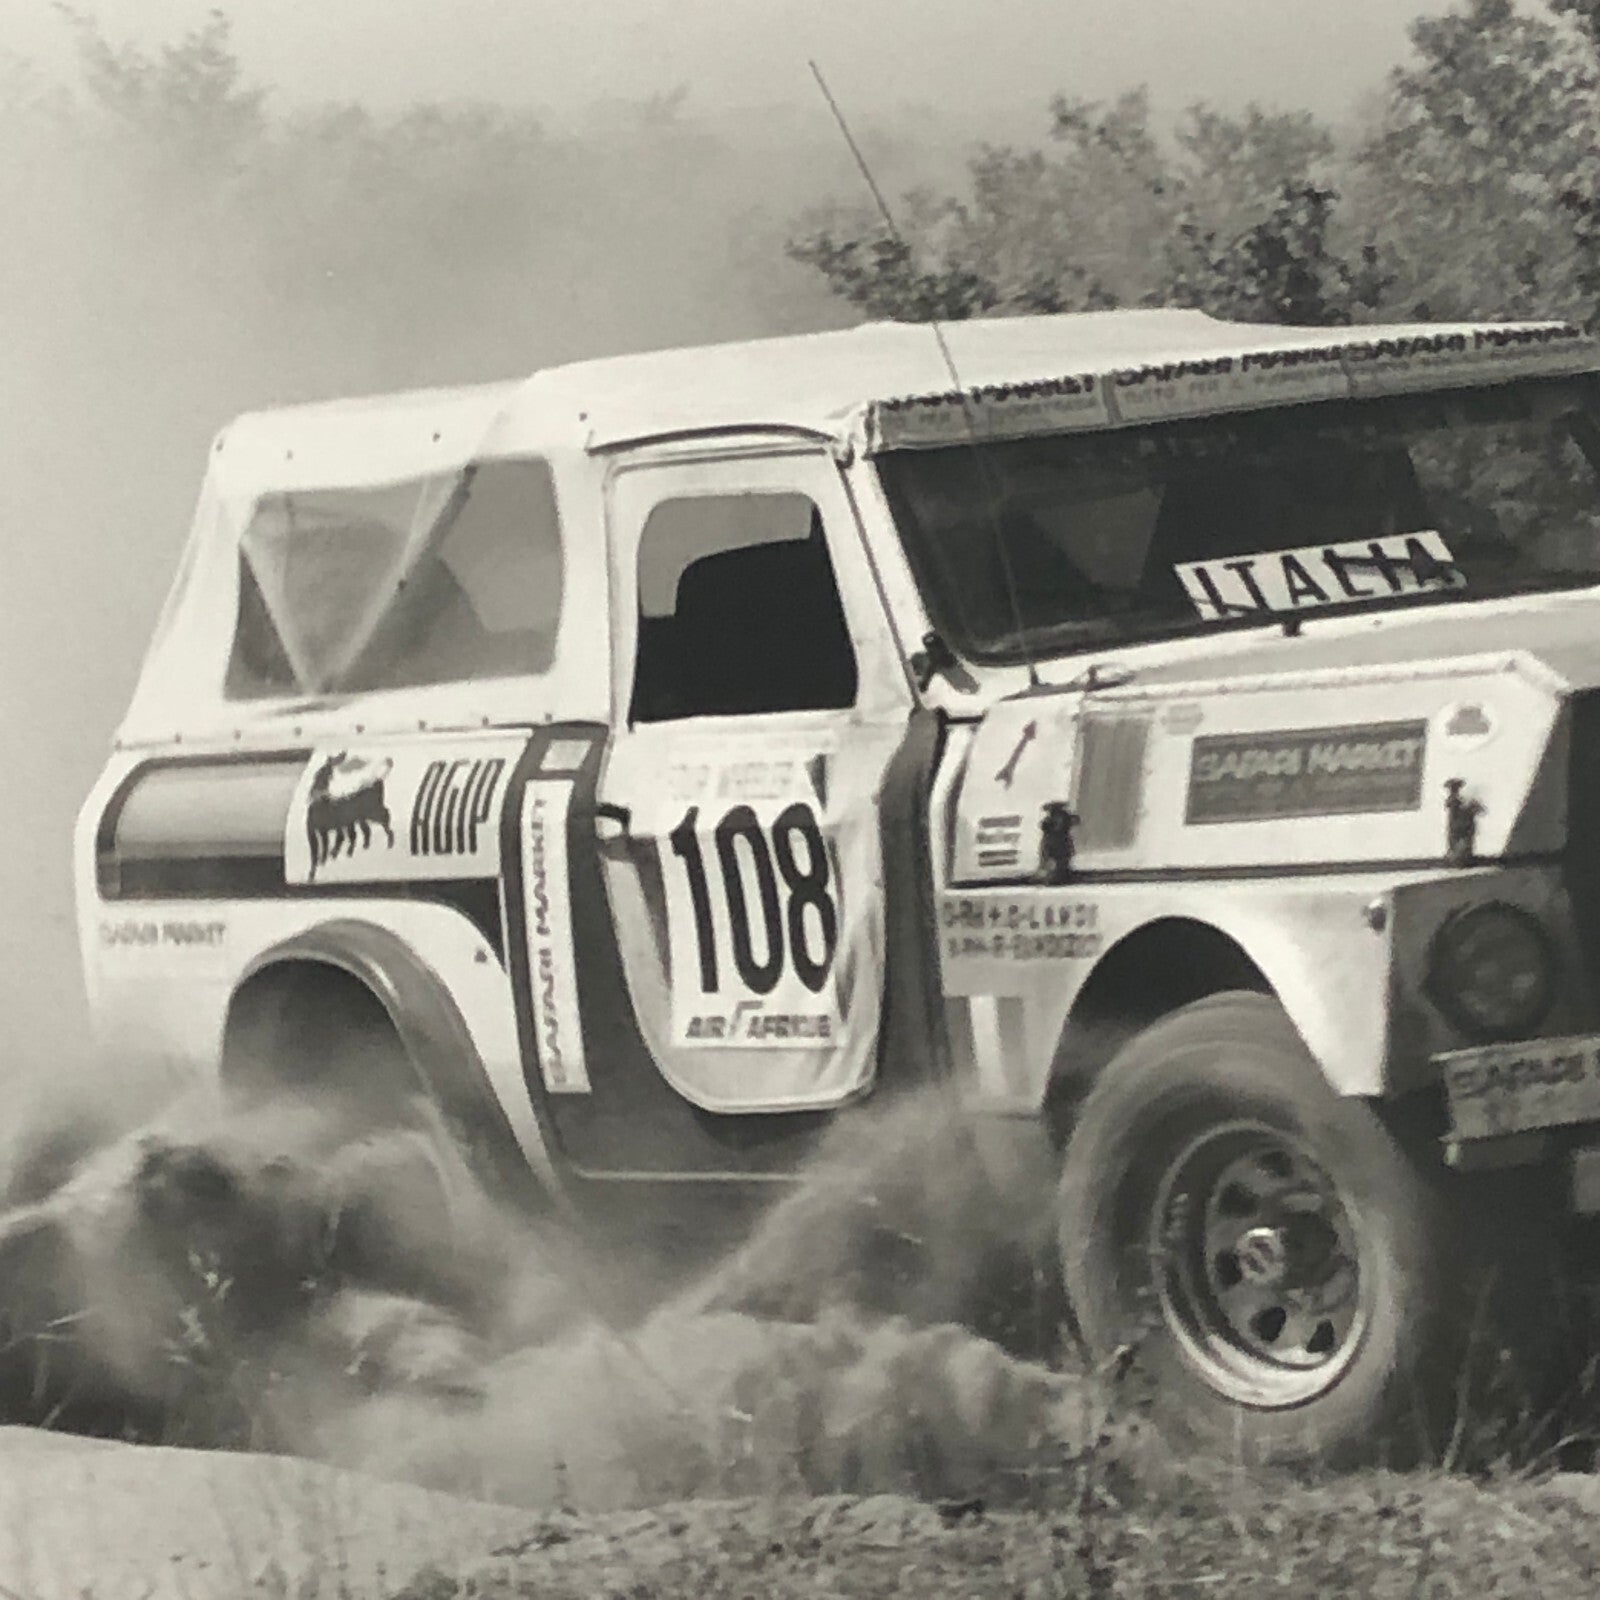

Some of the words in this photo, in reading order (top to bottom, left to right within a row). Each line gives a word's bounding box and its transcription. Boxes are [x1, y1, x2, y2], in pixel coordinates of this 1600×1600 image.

[1193, 537, 1451, 615] ITALIA
[410, 757, 506, 856] AGIP
[668, 801, 839, 996] 108
[685, 1015, 727, 1039] AIR
